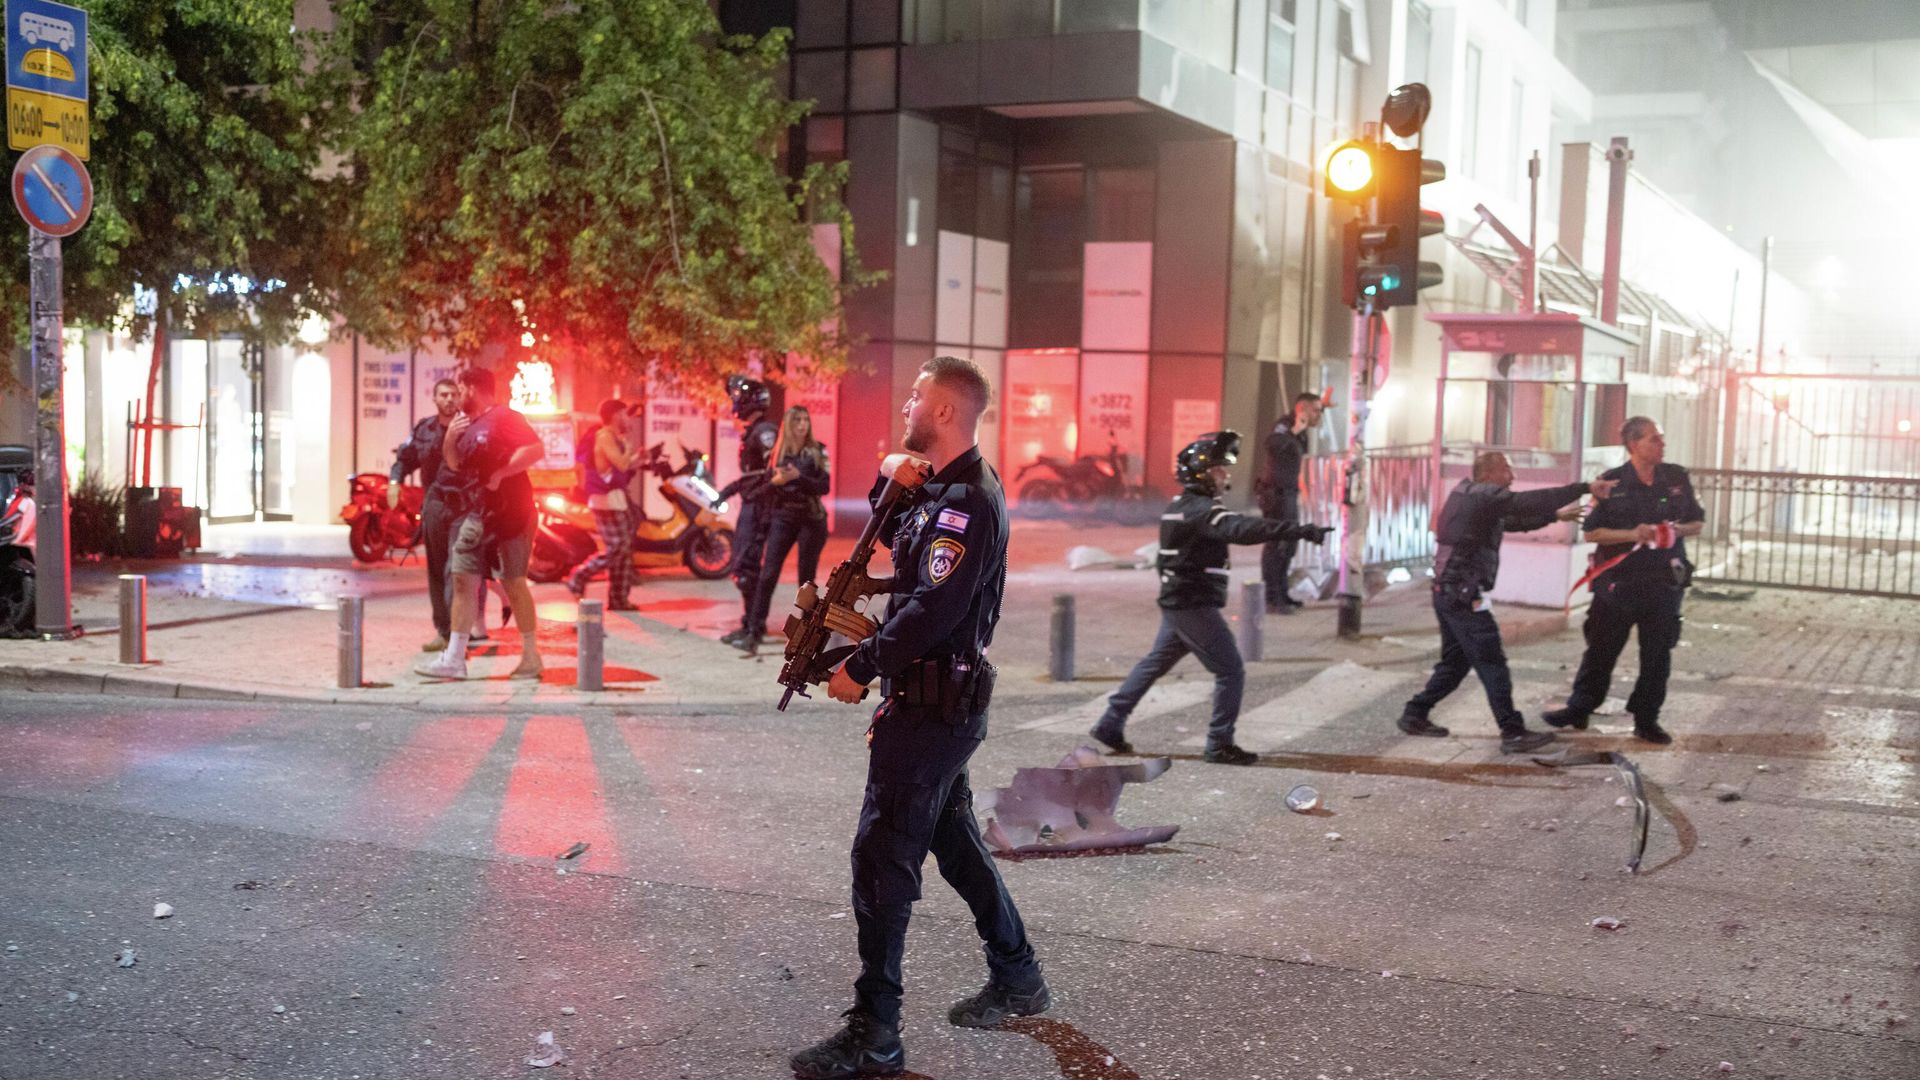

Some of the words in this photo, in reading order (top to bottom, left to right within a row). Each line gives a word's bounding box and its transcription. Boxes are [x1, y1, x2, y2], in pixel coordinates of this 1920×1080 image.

[13, 102, 43, 138] 06:00
[382, 362, 406, 373] ORE
[363, 378, 388, 388] CULD
[363, 393, 383, 403] YOU
[384, 394, 402, 403] NW
[652, 404, 676, 416] YOU
